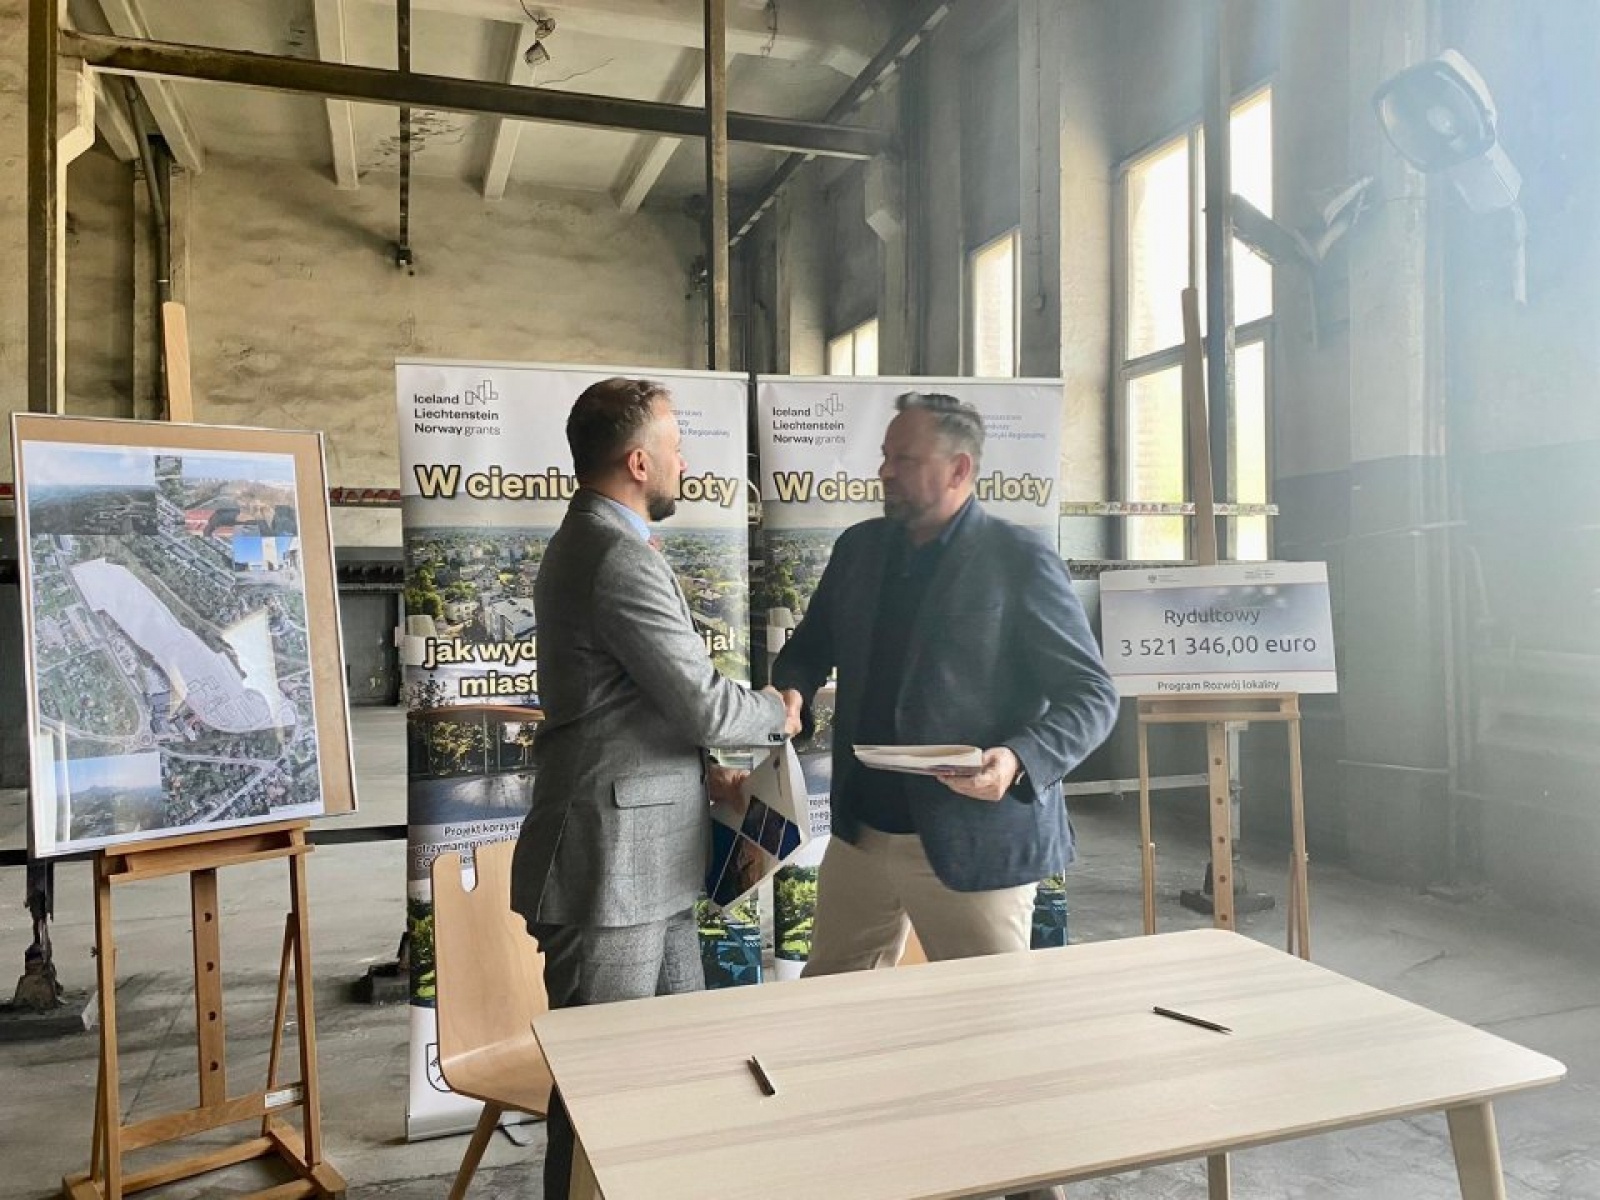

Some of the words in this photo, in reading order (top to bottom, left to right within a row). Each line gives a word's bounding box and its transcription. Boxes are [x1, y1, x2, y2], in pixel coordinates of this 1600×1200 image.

[414, 393, 459, 404] Iceland
[414, 408, 499, 420] Liechtenstein
[772, 407, 810, 416] Iceland
[414, 423, 462, 435] Norway
[465, 426, 500, 437] grants
[772, 420, 844, 430] Liechtenstein
[772, 435, 813, 445] Norway
[413, 465, 460, 498] W
[773, 471, 813, 502] W
[817, 471, 885, 502] cien
[977, 470, 1053, 507] rloty
[422, 636, 475, 670] jak
[478, 634, 537, 666] wyd
[1121, 639, 1133, 656] 3
[1140, 638, 1176, 656] 521
[1185, 636, 1259, 657] 346,00
[1265, 637, 1316, 653] euro
[460, 669, 538, 698] miast
[1157, 681, 1201, 692] Program
[1203, 680, 1241, 691] Rozwój
[1243, 679, 1280, 691] lokalny
[445, 825, 481, 836] Projekt
[482, 821, 520, 834] korzyst
